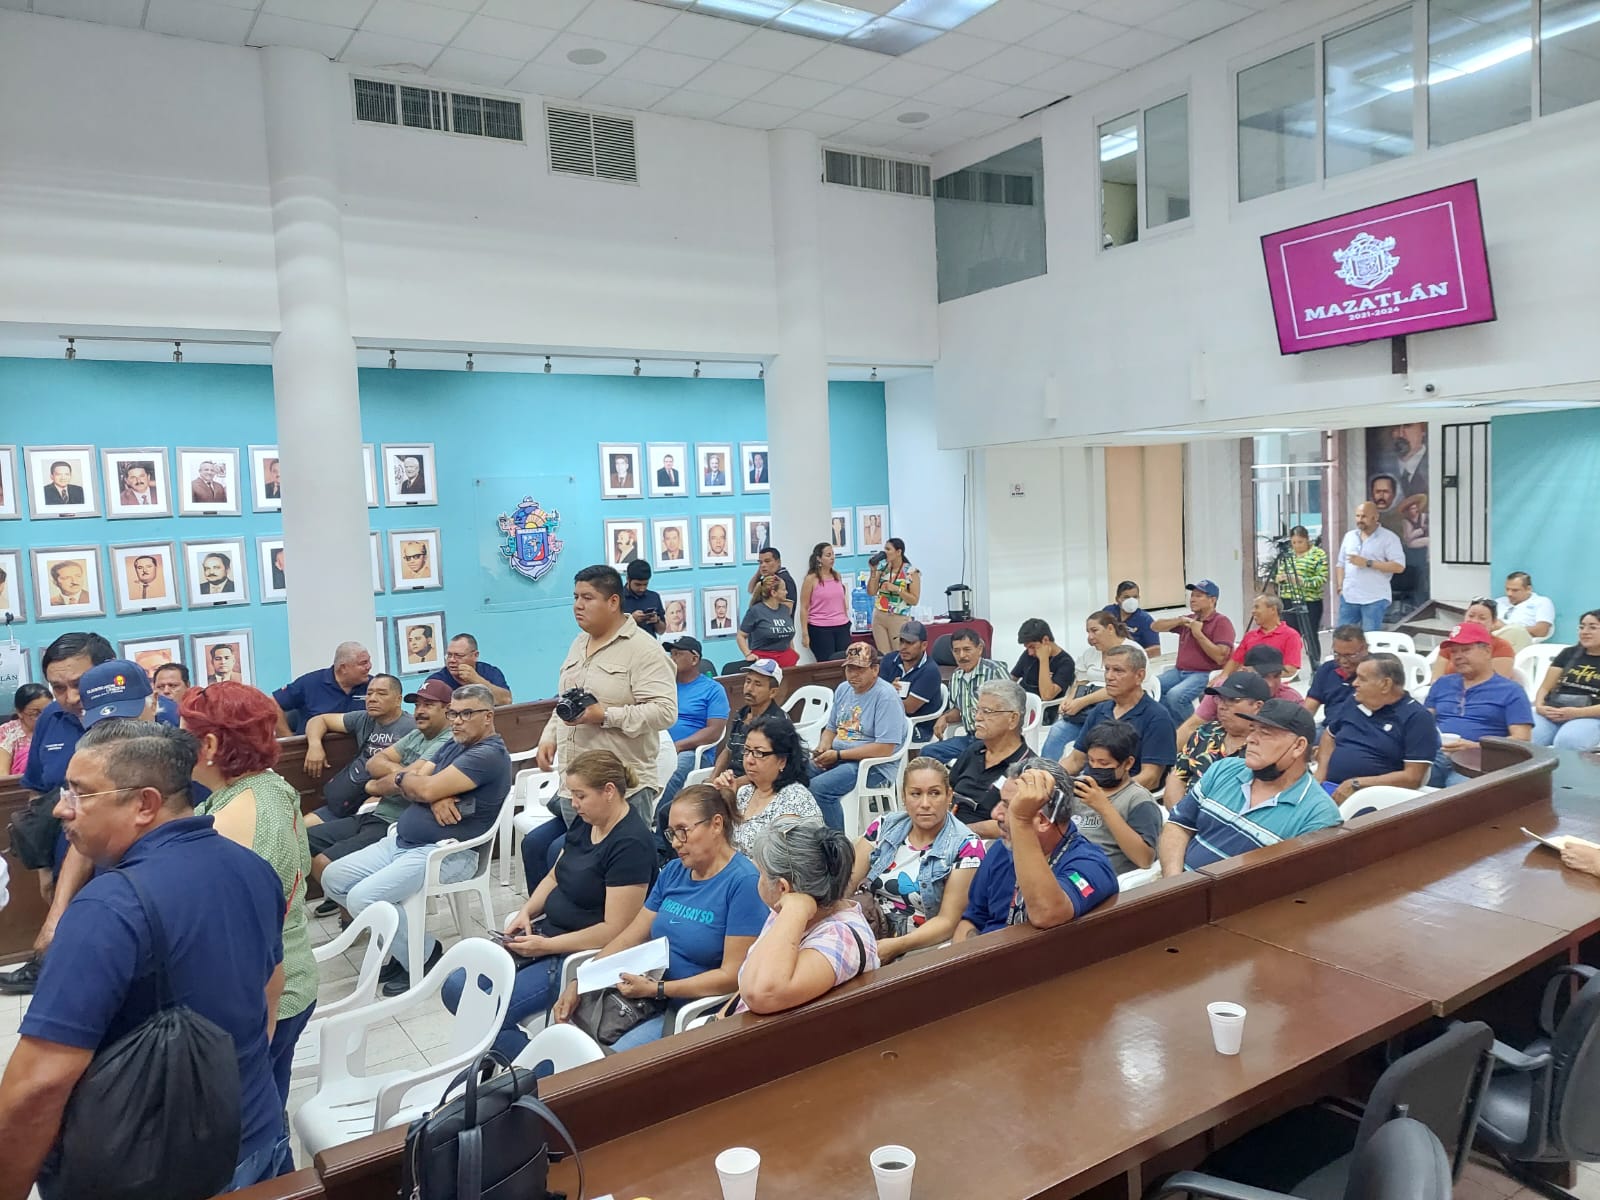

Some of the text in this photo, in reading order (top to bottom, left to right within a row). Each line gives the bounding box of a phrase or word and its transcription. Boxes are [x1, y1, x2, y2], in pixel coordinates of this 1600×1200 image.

[1304, 282, 1449, 321] MAZATLÁN
[1348, 306, 1400, 321] 2021-2024
[683, 906, 702, 921] SAY
[700, 910, 715, 925] SO
